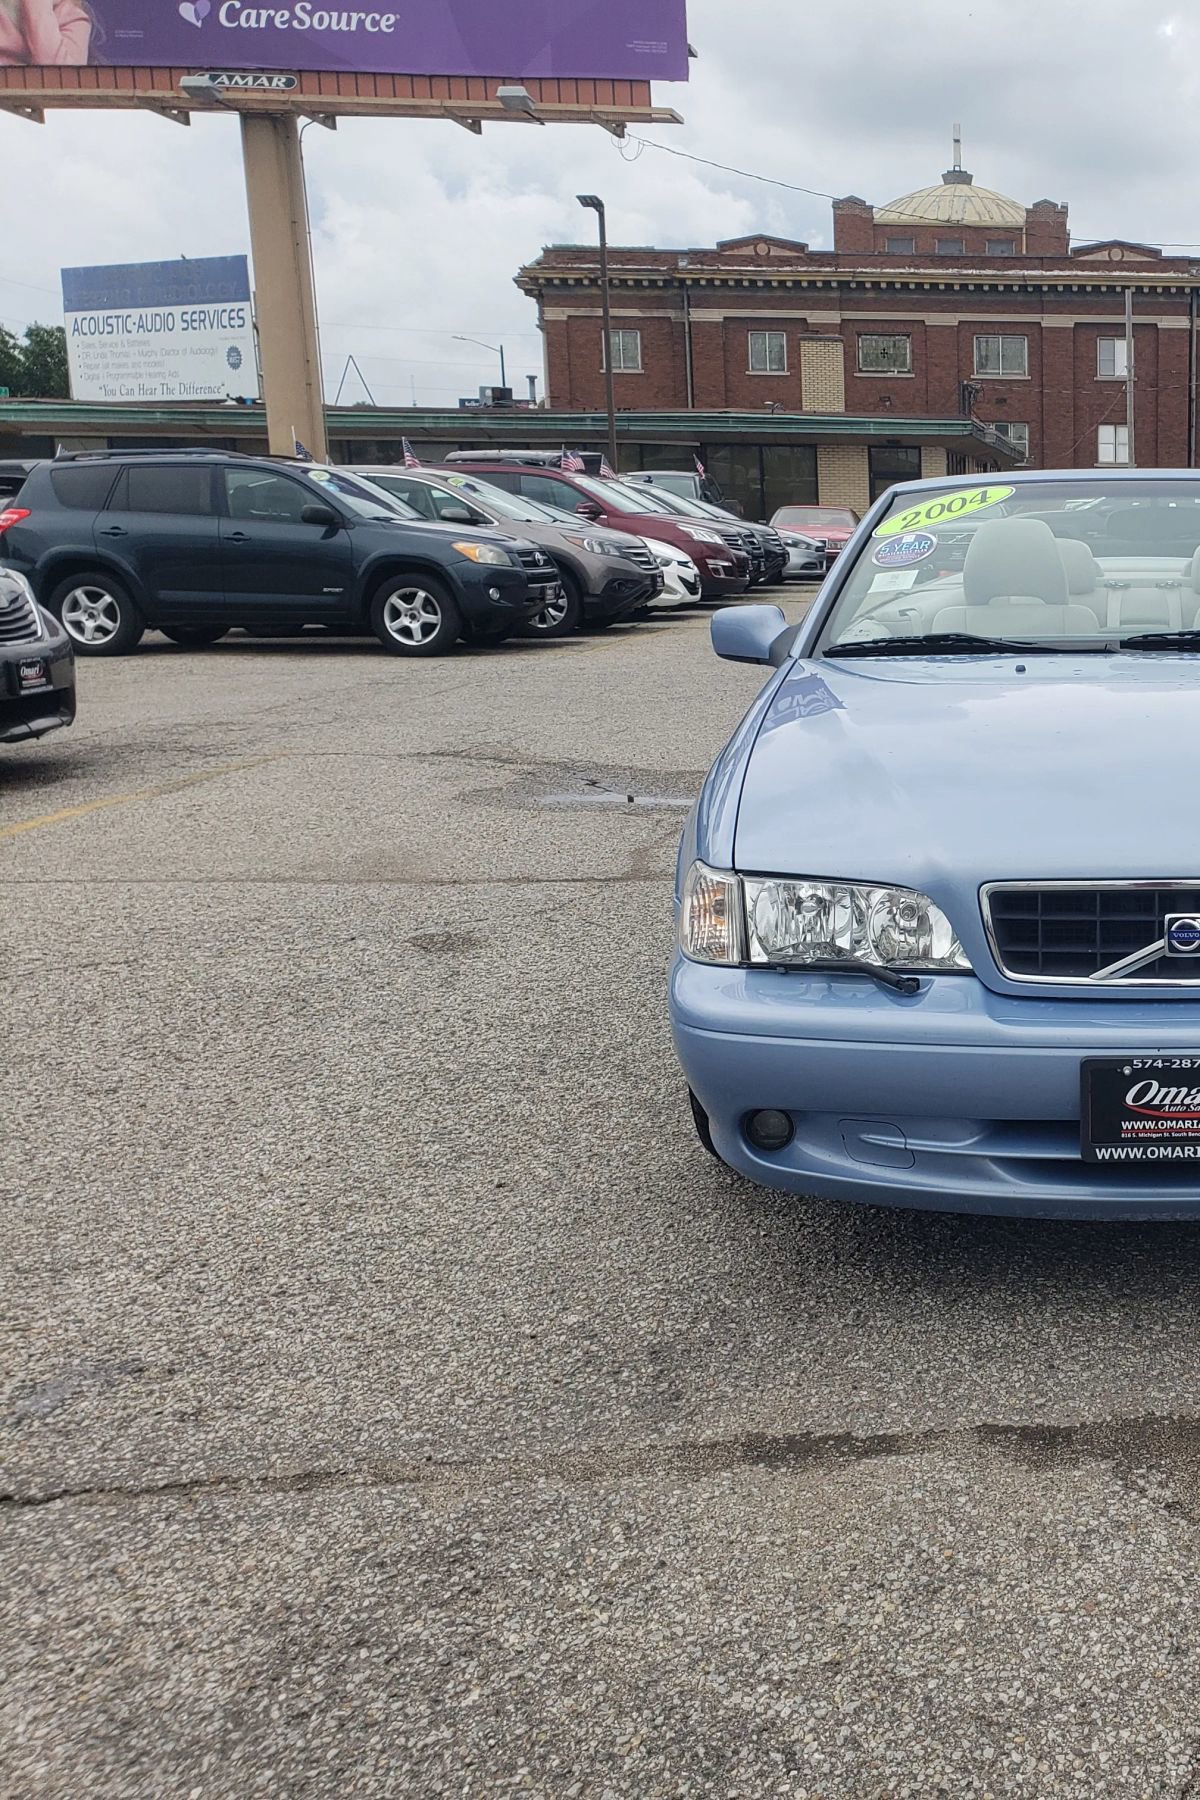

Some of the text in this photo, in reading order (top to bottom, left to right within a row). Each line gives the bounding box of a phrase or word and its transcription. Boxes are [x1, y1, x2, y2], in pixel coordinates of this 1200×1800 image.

[218, 0, 397, 33] CareSource
[214, 74, 287, 88] AMAR
[180, 308, 246, 331] SERVICES
[119, 383, 135, 397] Can
[138, 383, 158, 396] Hear
[160, 382, 176, 396] The
[900, 489, 992, 531] 2004
[880, 540, 931, 554] 5 YEAR
[1160, 1104, 1186, 1112] Auto
